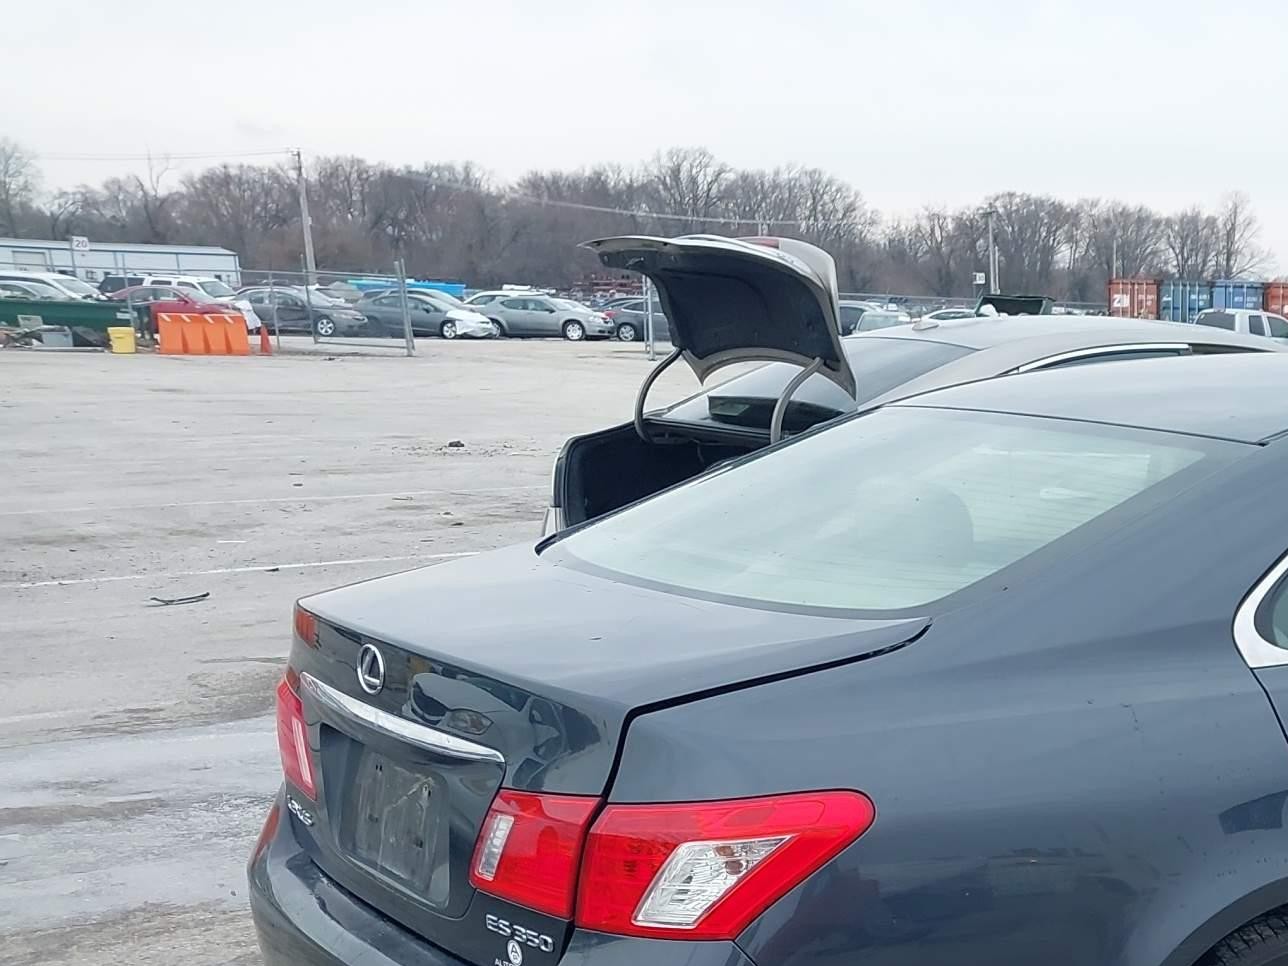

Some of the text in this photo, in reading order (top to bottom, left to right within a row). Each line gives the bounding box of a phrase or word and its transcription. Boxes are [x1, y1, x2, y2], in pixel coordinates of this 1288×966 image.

[75, 239, 87, 248] 20
[486, 914, 554, 952] ES 350
